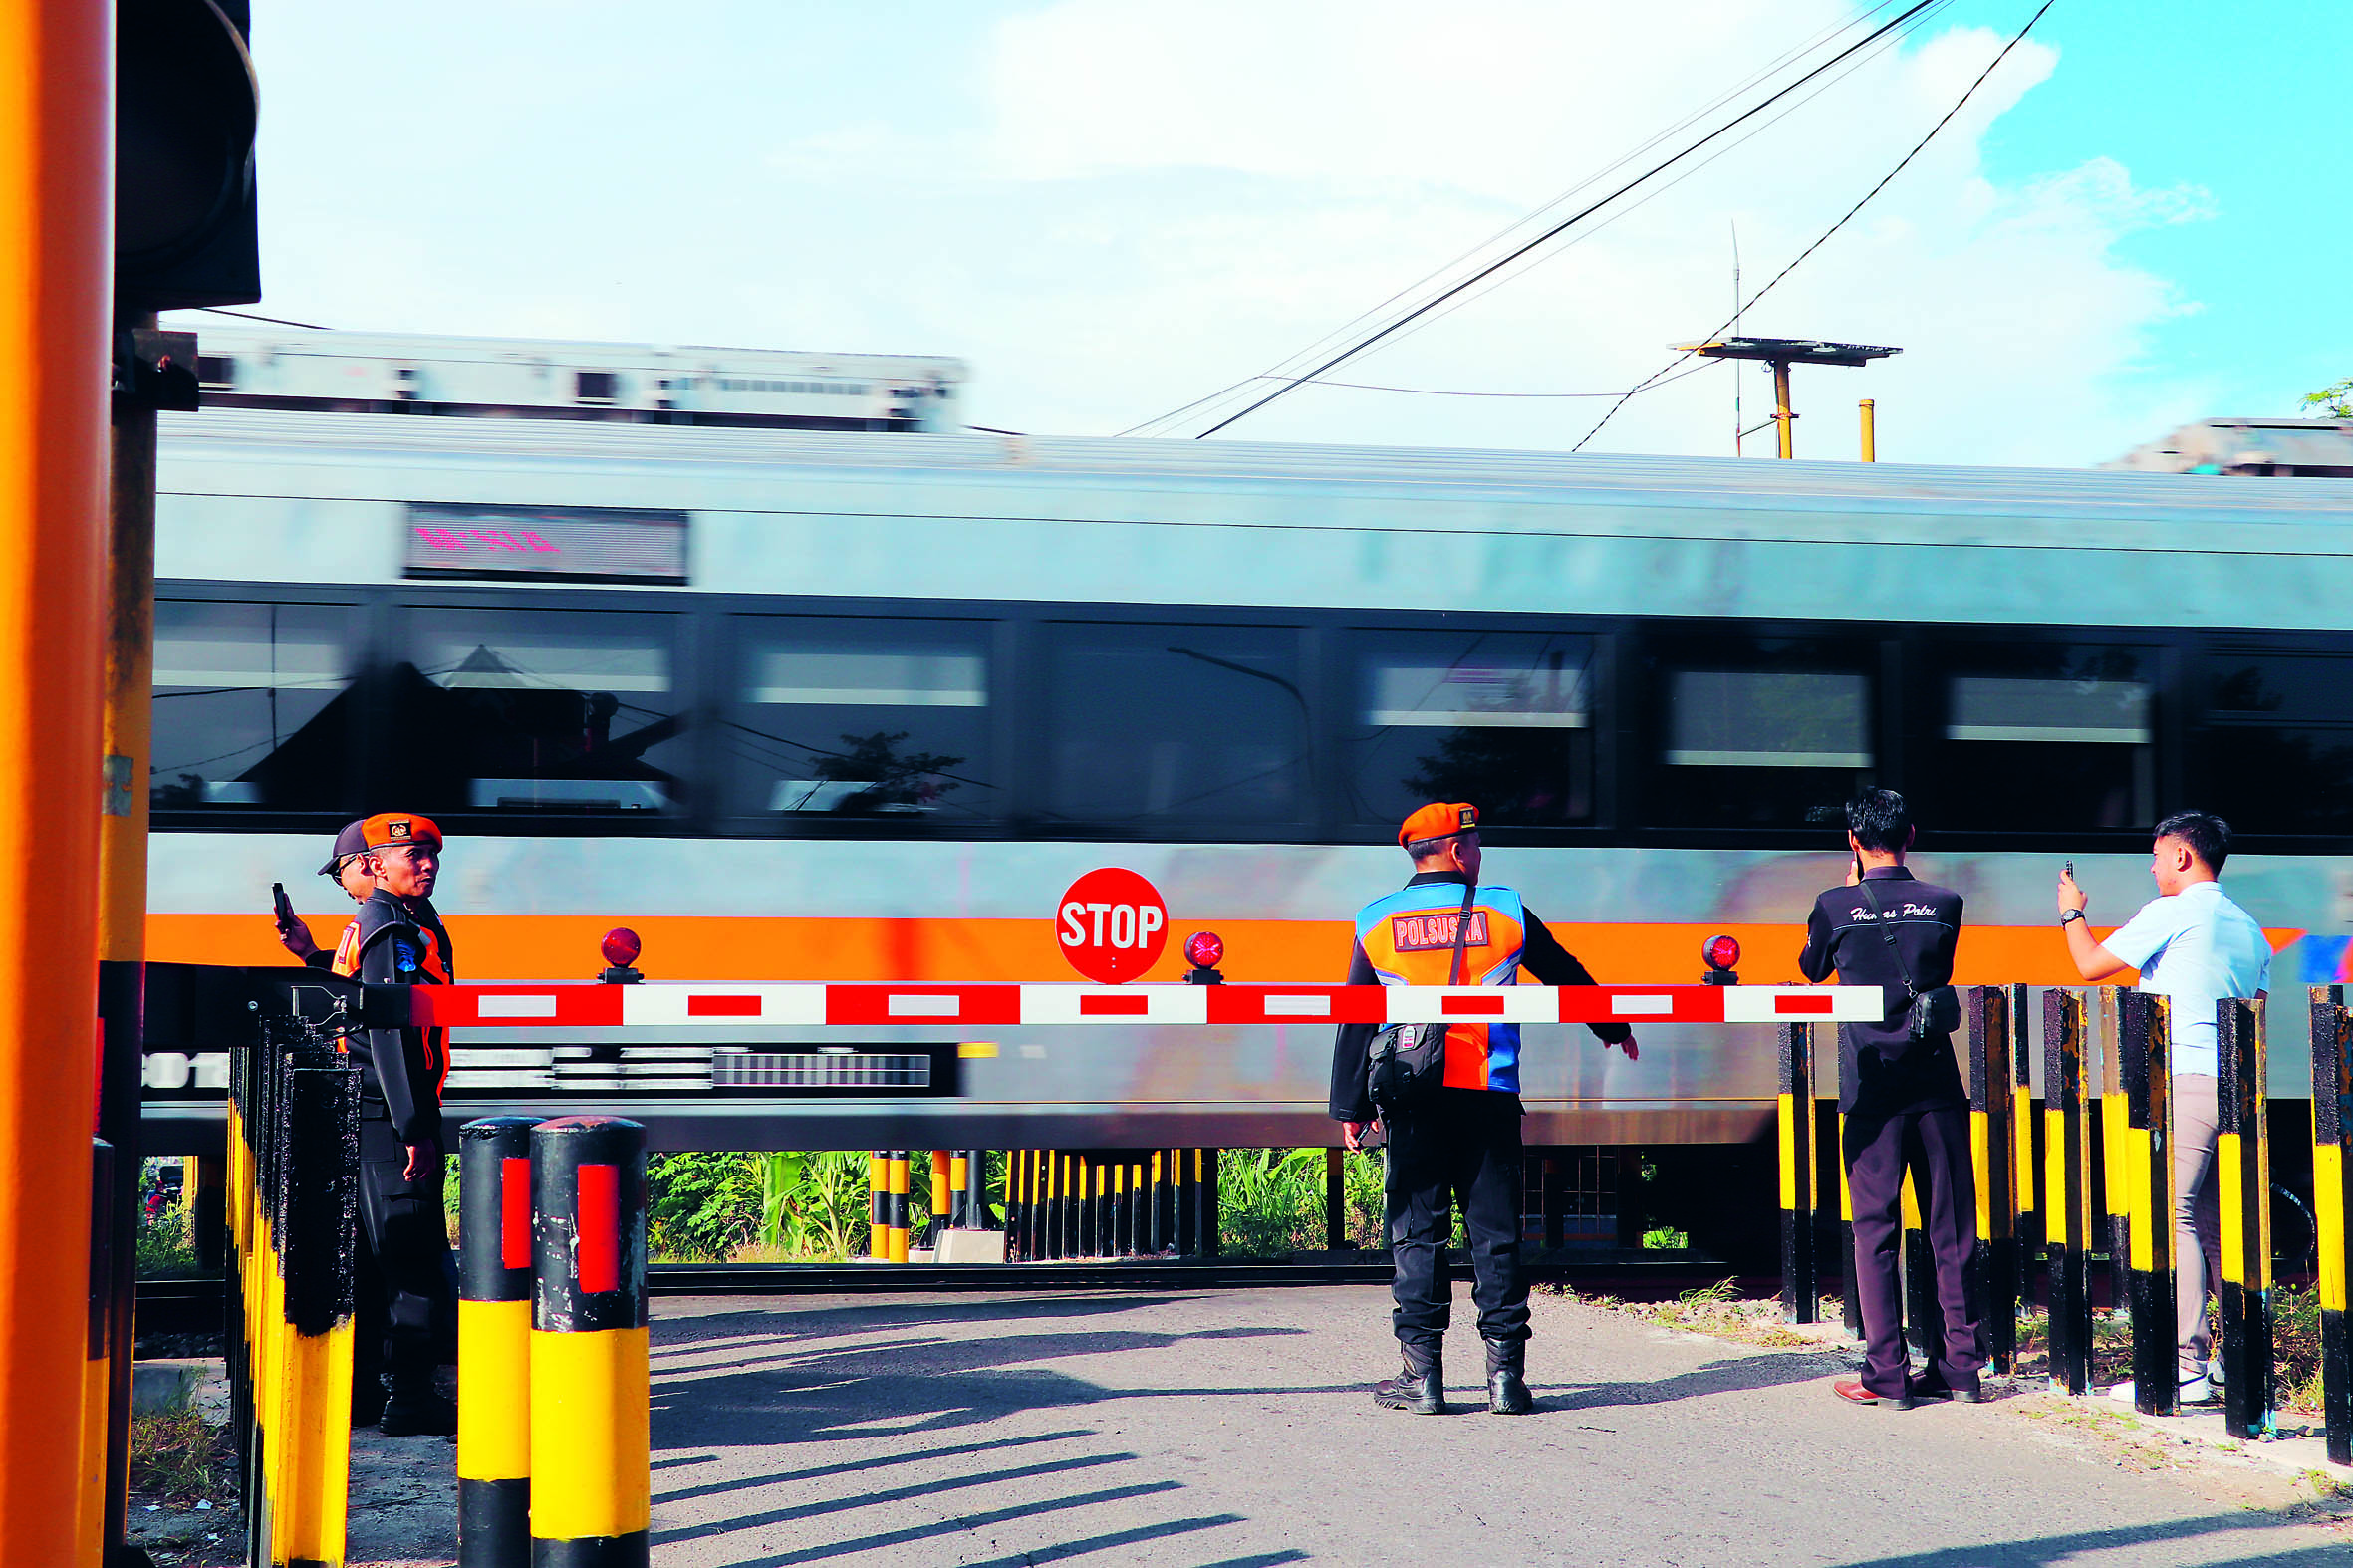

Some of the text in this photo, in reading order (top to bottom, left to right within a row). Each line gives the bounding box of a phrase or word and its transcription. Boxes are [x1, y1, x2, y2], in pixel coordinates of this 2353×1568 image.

[1061, 902, 1163, 948] STOP
[1902, 903, 1937, 917] Polri
[1396, 915, 1483, 947] POLSUSA
